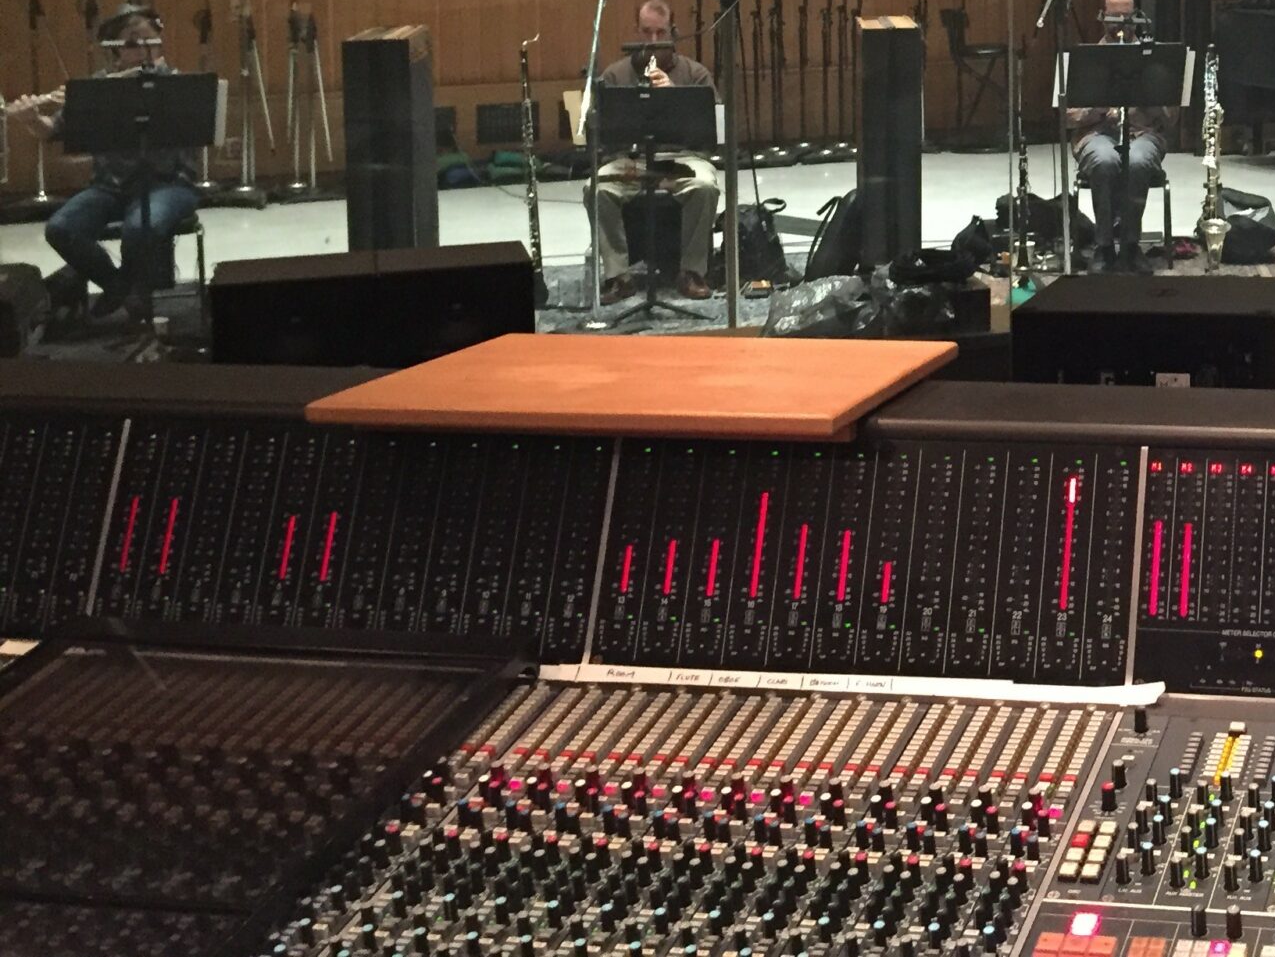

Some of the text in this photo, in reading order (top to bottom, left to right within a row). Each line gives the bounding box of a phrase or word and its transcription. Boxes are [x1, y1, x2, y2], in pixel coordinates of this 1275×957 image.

[791, 602, 799, 610] 17
[923, 607, 932, 616] 20
[968, 609, 976, 617] 21
[1012, 611, 1022, 619] 22
[1057, 612, 1067, 621] 23
[1102, 614, 1113, 623] 24
[1222, 629, 1241, 637] METER
[1242, 630, 1272, 638] SELECTOR
[675, 673, 701, 681] FLUTE
